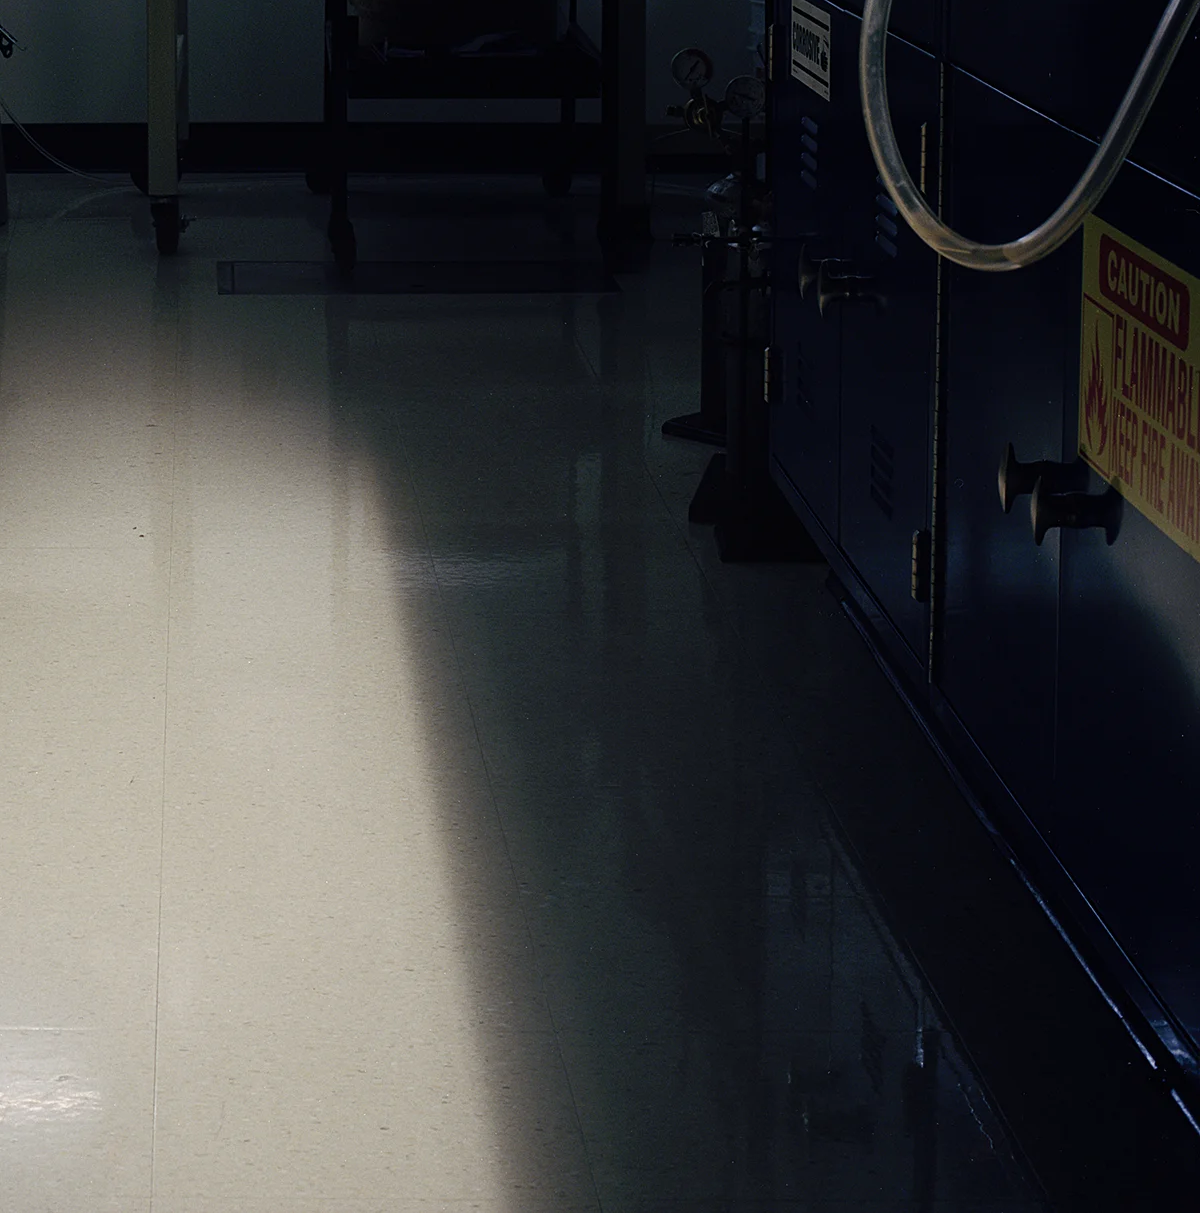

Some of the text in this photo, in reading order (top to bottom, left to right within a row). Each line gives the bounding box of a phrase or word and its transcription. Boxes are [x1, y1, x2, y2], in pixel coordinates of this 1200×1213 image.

[1107, 249, 1180, 336] CAUTION
[1112, 395, 1200, 546] KEEP FIRE AWA
